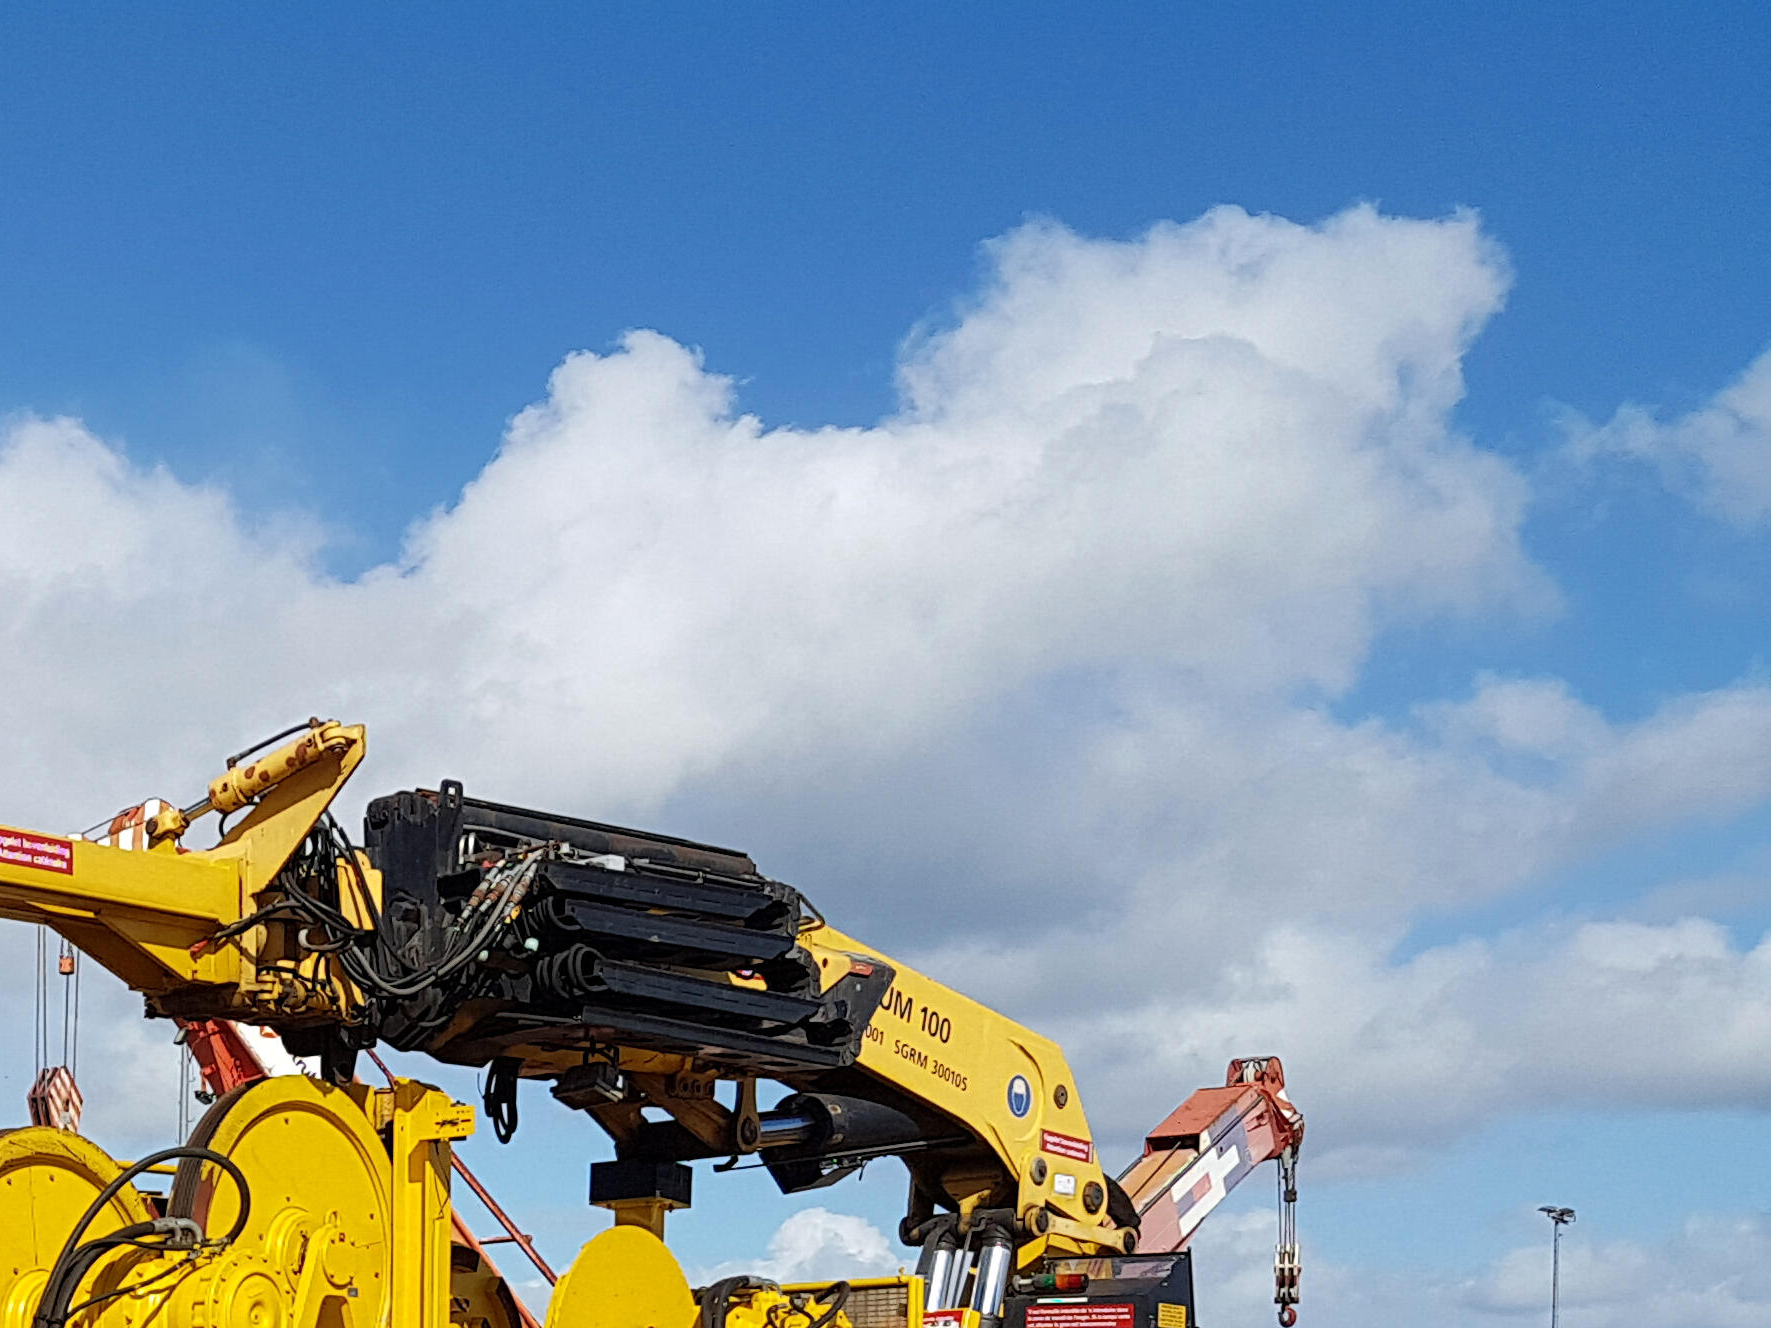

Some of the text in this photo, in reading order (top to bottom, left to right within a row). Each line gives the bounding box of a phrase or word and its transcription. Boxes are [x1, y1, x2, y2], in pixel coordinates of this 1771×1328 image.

[920, 1005, 951, 1044] 100
[893, 1039, 928, 1070] SGRM
[931, 1060, 968, 1092] 300105
